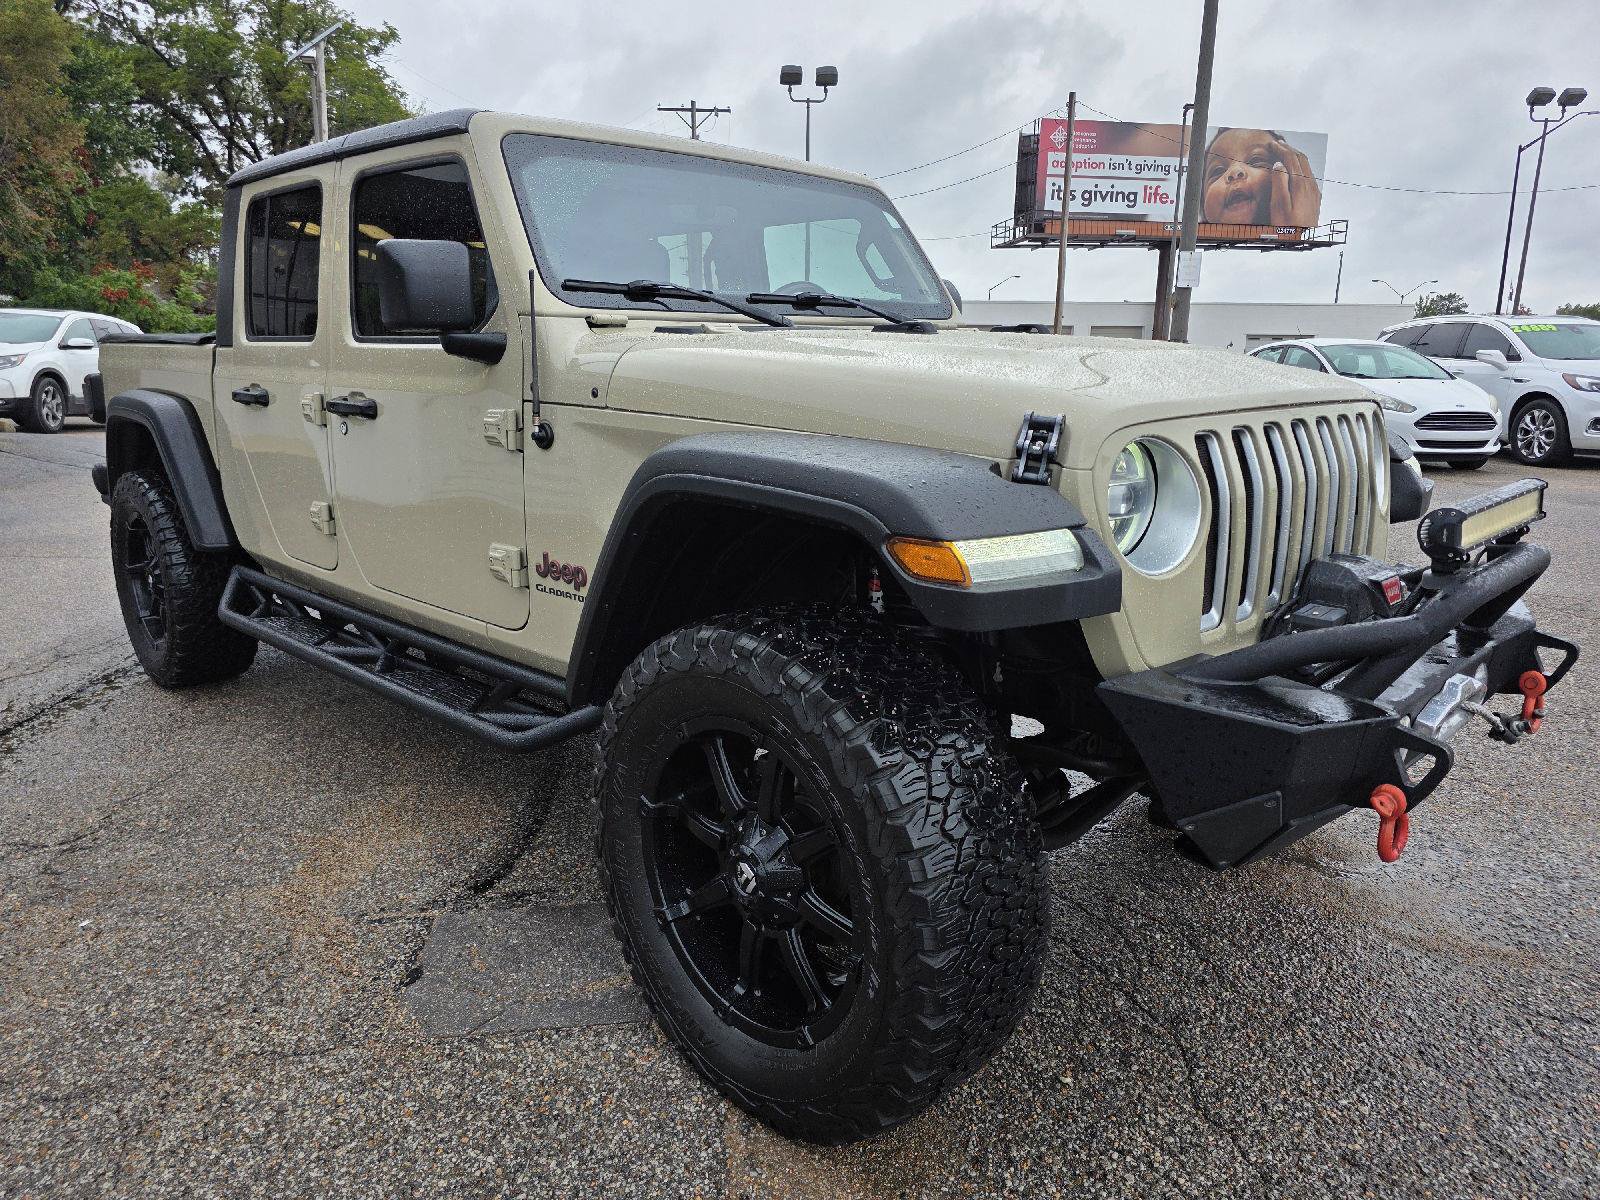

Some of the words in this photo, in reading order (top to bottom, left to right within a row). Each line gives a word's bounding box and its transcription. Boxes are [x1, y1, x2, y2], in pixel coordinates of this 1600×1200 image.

[1108, 158, 1133, 171] isn't
[1135, 160, 1171, 176] giving
[1050, 182, 1077, 202] its
[1081, 184, 1138, 209] giving
[1142, 184, 1175, 205] life.
[536, 551, 588, 592] Jeep
[536, 583, 586, 603] GLADIATO
